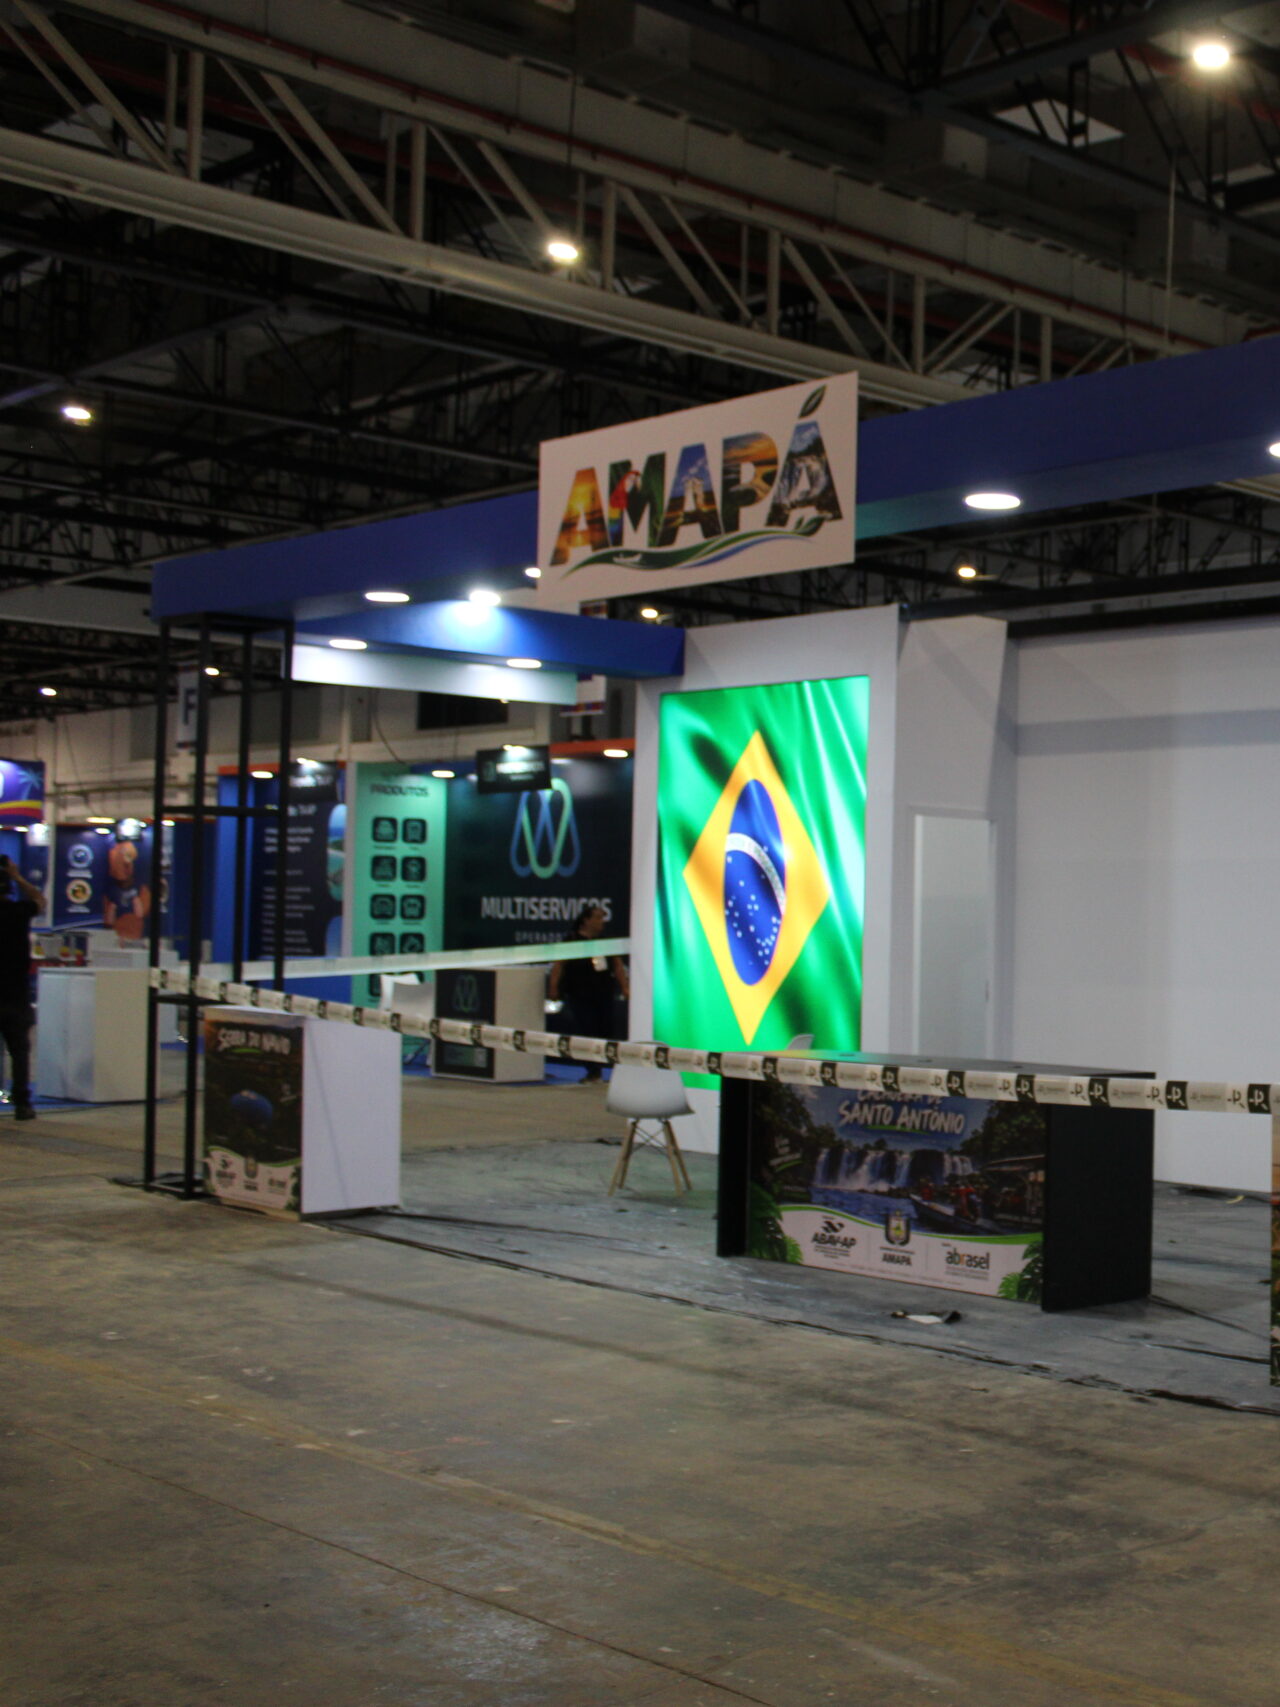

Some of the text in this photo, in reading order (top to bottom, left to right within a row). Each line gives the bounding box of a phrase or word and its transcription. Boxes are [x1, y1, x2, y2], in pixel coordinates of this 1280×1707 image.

[549, 384, 843, 567] AMAPÁ
[369, 783, 428, 797] PRODUTOS
[838, 1100, 894, 1127] SANTO
[945, 1248, 990, 1270] abrasel
